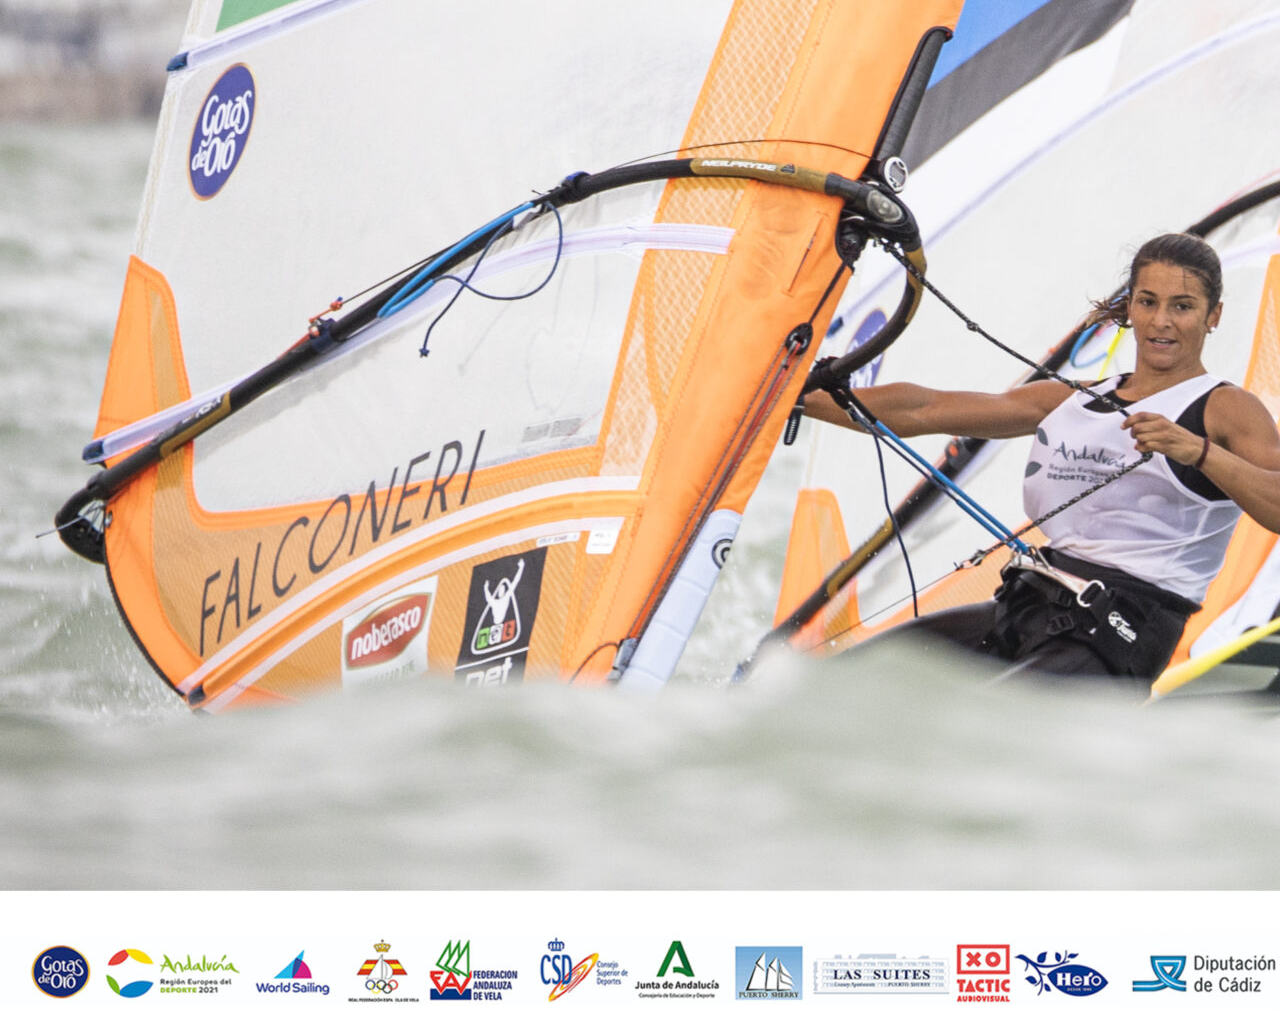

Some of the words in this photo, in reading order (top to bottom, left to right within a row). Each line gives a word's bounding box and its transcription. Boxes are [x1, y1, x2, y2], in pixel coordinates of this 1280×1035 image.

[202, 89, 253, 147] Gotas
[191, 146, 208, 171] de
[204, 132, 236, 177] Oro
[1047, 473, 1087, 482] DEPORTE
[200, 429, 486, 658] FALCONERI
[351, 606, 421, 660] noberasco
